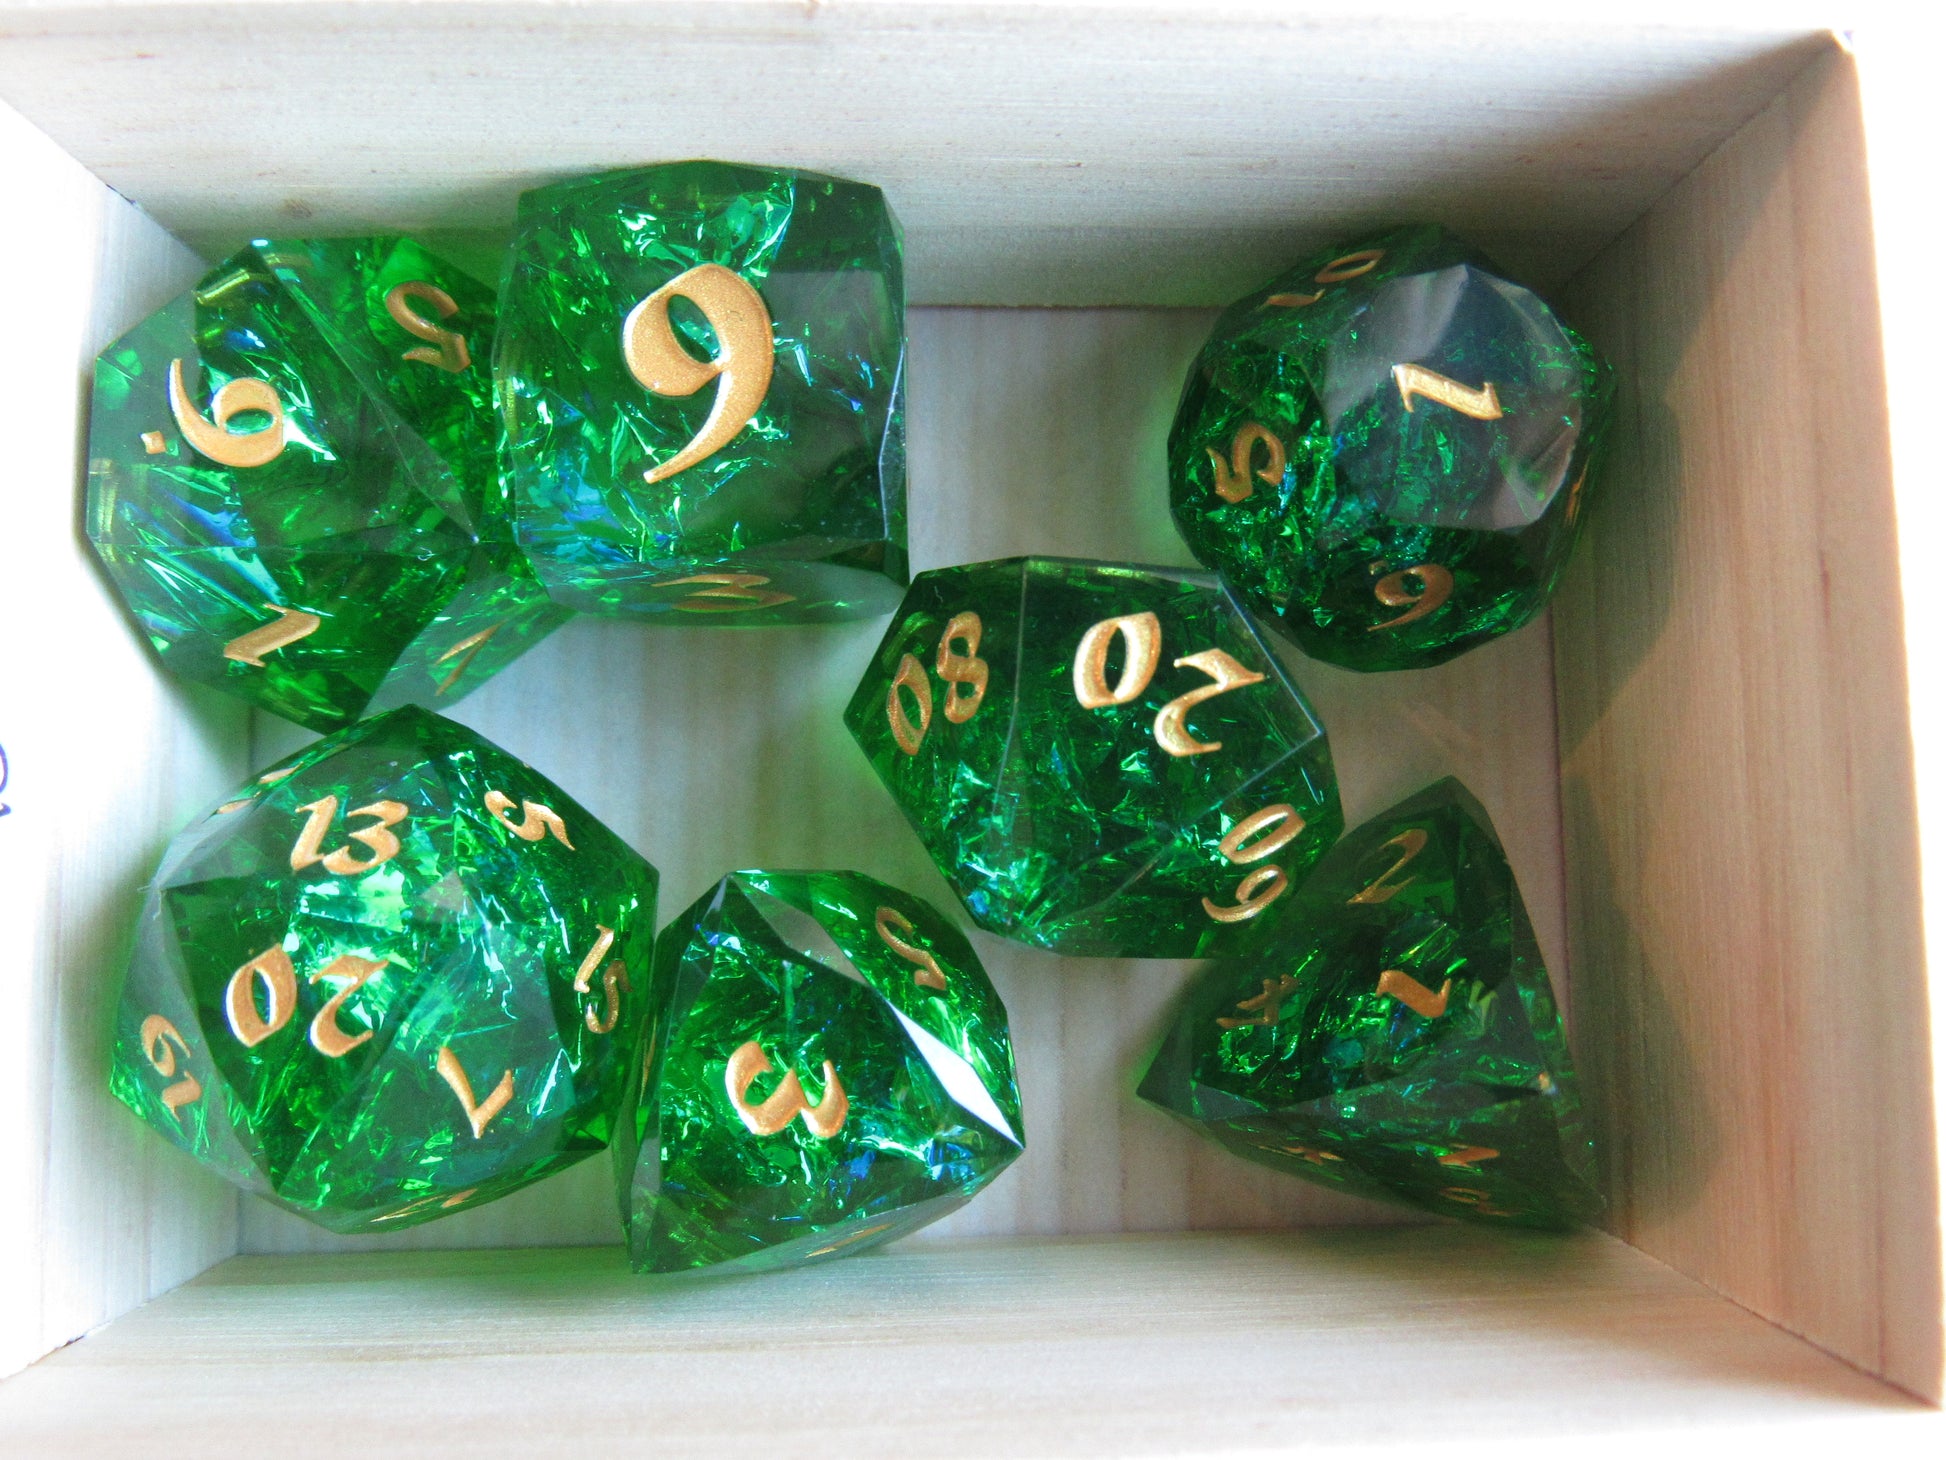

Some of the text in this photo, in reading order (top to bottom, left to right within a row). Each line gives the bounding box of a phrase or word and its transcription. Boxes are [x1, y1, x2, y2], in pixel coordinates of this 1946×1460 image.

[1391, 362, 1503, 420] 1
[1206, 423, 1286, 503] 5
[887, 611, 989, 755] 80
[1073, 611, 1264, 757] 20
[291, 795, 408, 875] 13
[225, 943, 388, 1057] 20
[725, 1040, 849, 1138] 3
